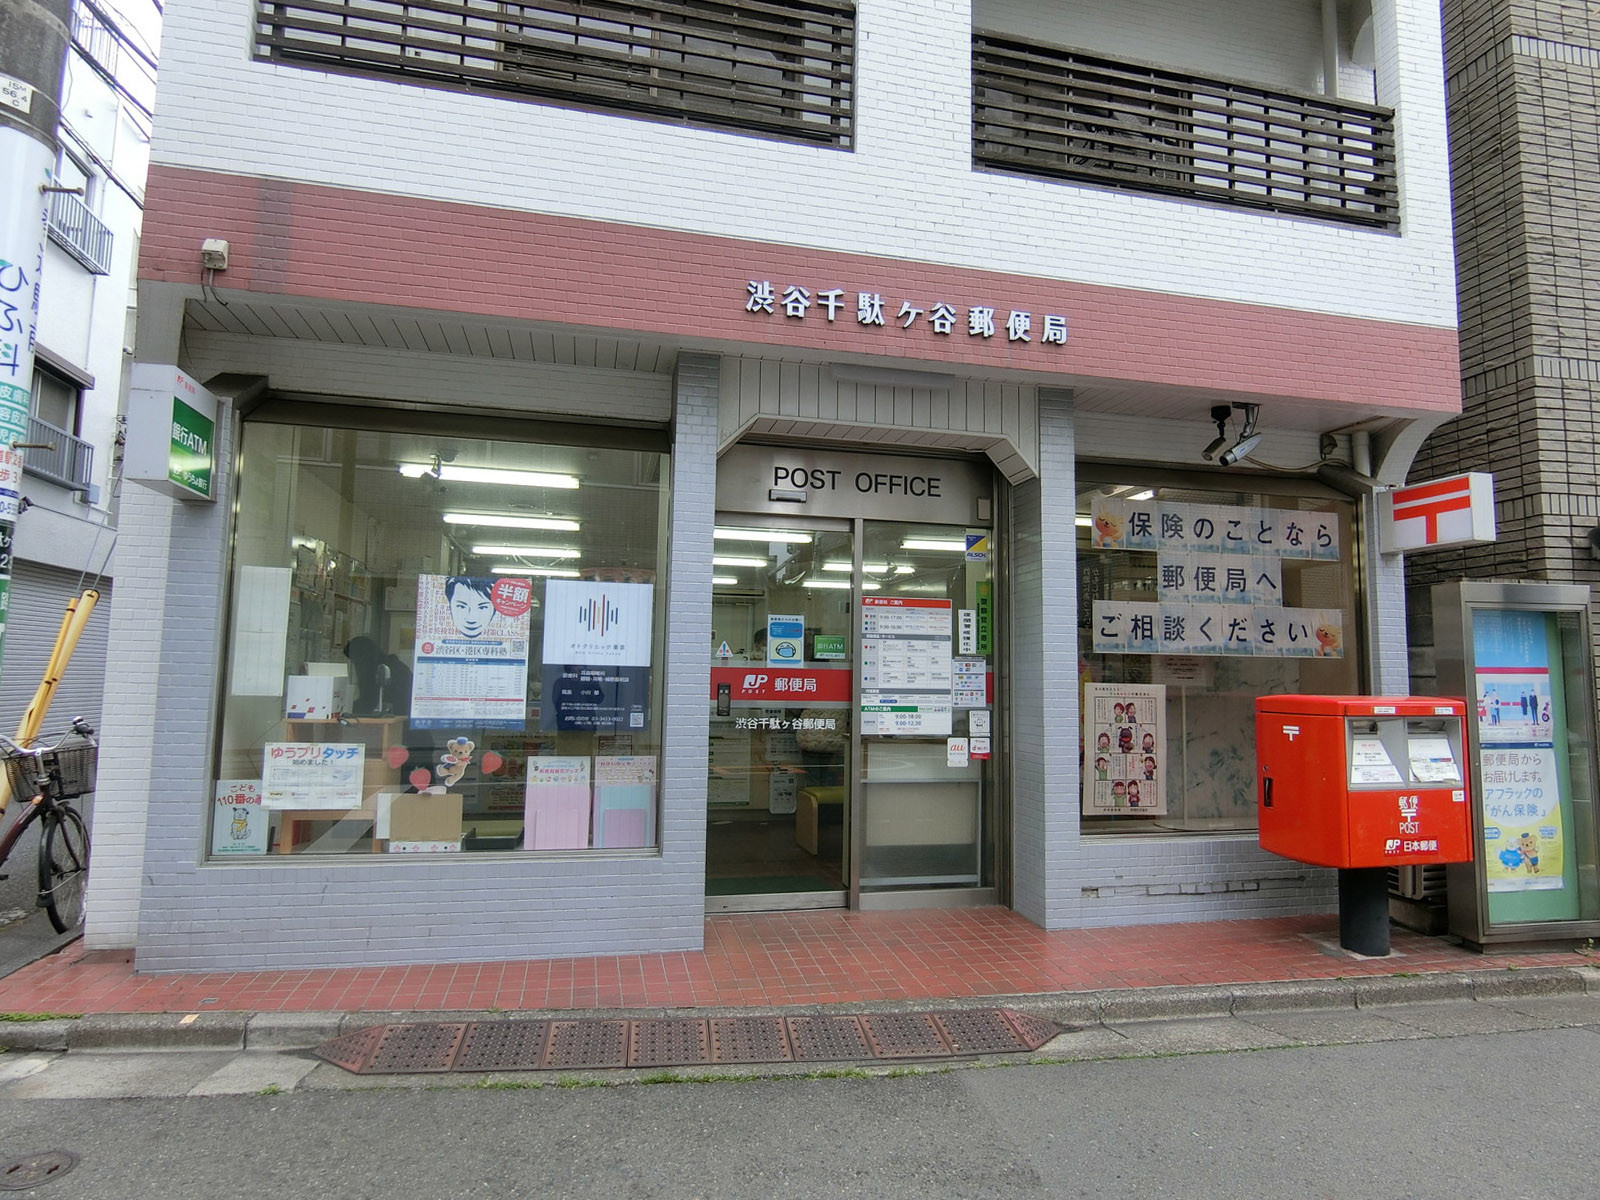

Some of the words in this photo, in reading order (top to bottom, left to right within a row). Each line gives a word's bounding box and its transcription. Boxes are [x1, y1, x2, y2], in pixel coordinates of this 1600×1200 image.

[172, 422, 208, 456] 銀行ATM
[773, 466, 842, 491] POST
[855, 472, 942, 498] OFFICE
[1128, 511, 1334, 547] 保険のことなら
[1162, 565, 1278, 593] 郵便局へ
[497, 583, 530, 603] 半額
[1101, 613, 1309, 643] ご相談ください
[742, 674, 769, 689] JP
[774, 677, 818, 693] 郵便局
[950, 744, 966, 752] au
[1482, 753, 1543, 767] 郵便局から
[1483, 770, 1543, 784] お届けします。
[230, 784, 256, 793] こども
[1485, 787, 1544, 800] アフラックの
[1398, 796, 1419, 810] 郵便
[1485, 803, 1547, 817] 「がん保険」
[1399, 822, 1420, 835] POST
[1403, 840, 1438, 852] 日本郵便
